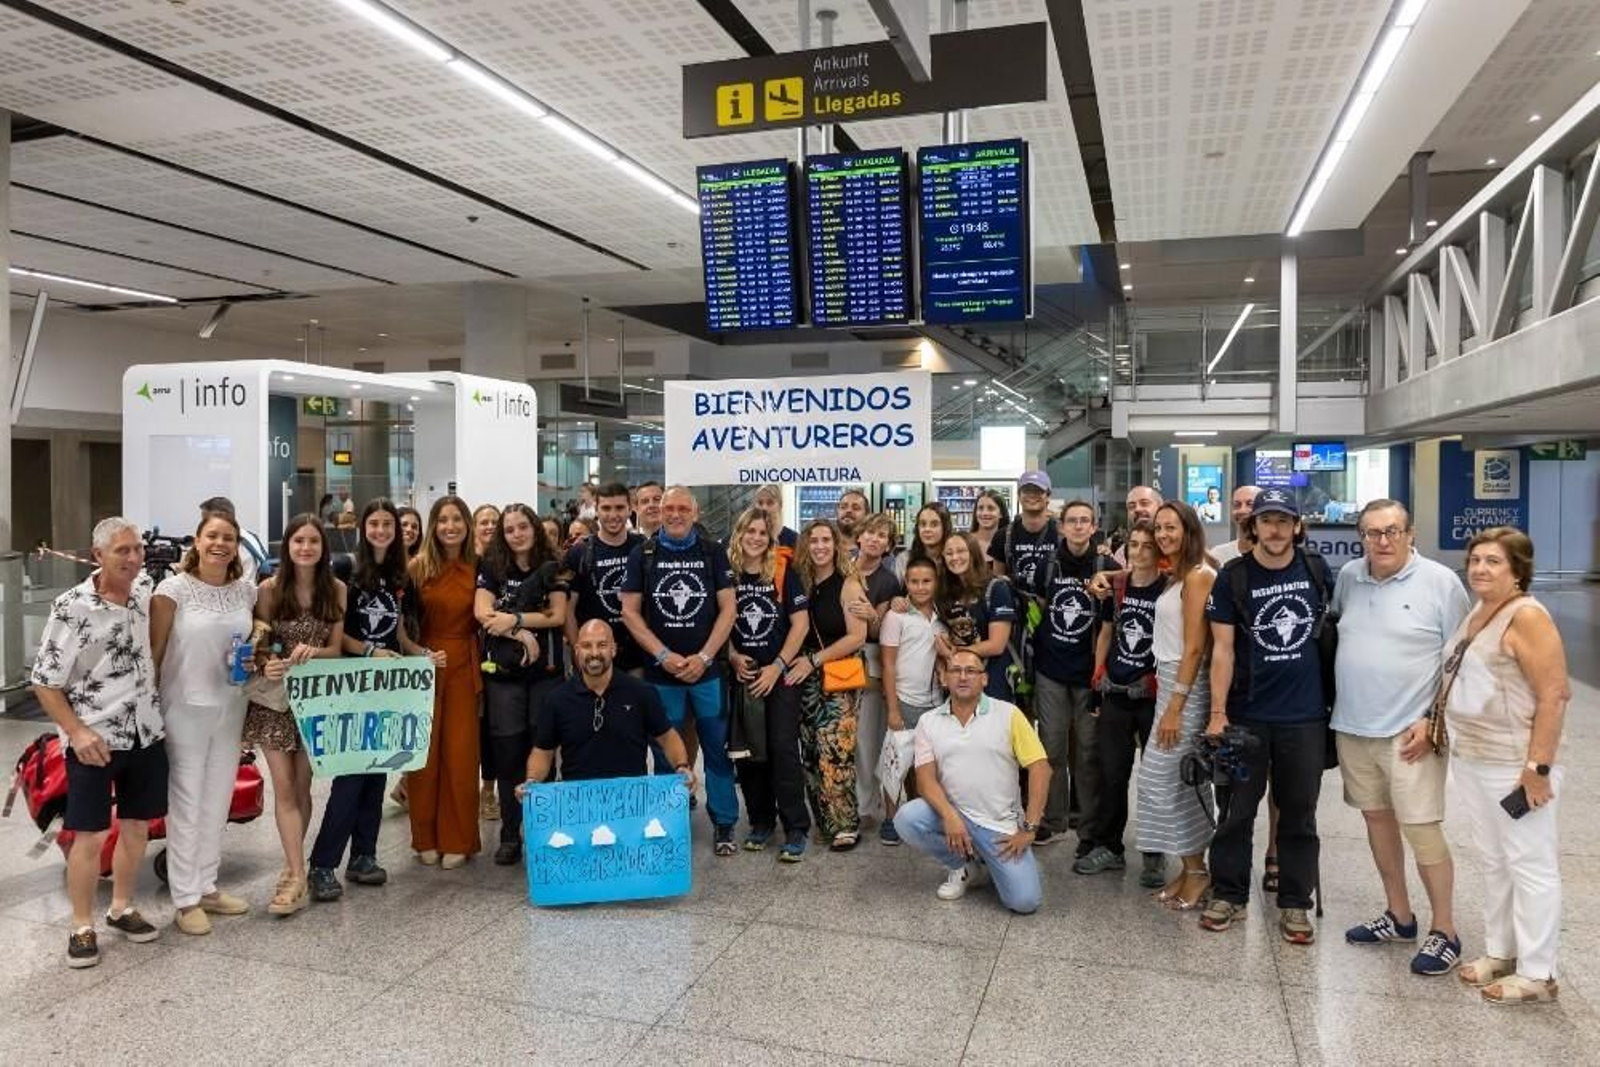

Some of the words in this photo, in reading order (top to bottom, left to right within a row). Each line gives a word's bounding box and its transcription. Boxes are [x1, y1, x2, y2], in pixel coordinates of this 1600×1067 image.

[813, 53, 870, 73] Ankunft
[813, 73, 870, 92] Arrivals
[814, 90, 902, 114] Llegadas
[961, 222, 989, 233] 19:48
[195, 377, 246, 407] info
[694, 386, 911, 416] BIENVENIDOS
[504, 392, 530, 417] info
[692, 423, 914, 451] AVENTUREROS
[739, 467, 862, 483] DINGONATURA
[1453, 516, 1521, 526] EXCHANGE
[1464, 507, 1519, 517] CURRENCY
[1305, 536, 1364, 559] hang
[286, 668, 433, 700] BIENVENIDOS
[300, 710, 432, 757] VENTUREROS
[528, 780, 688, 830] BIENVENIDOS
